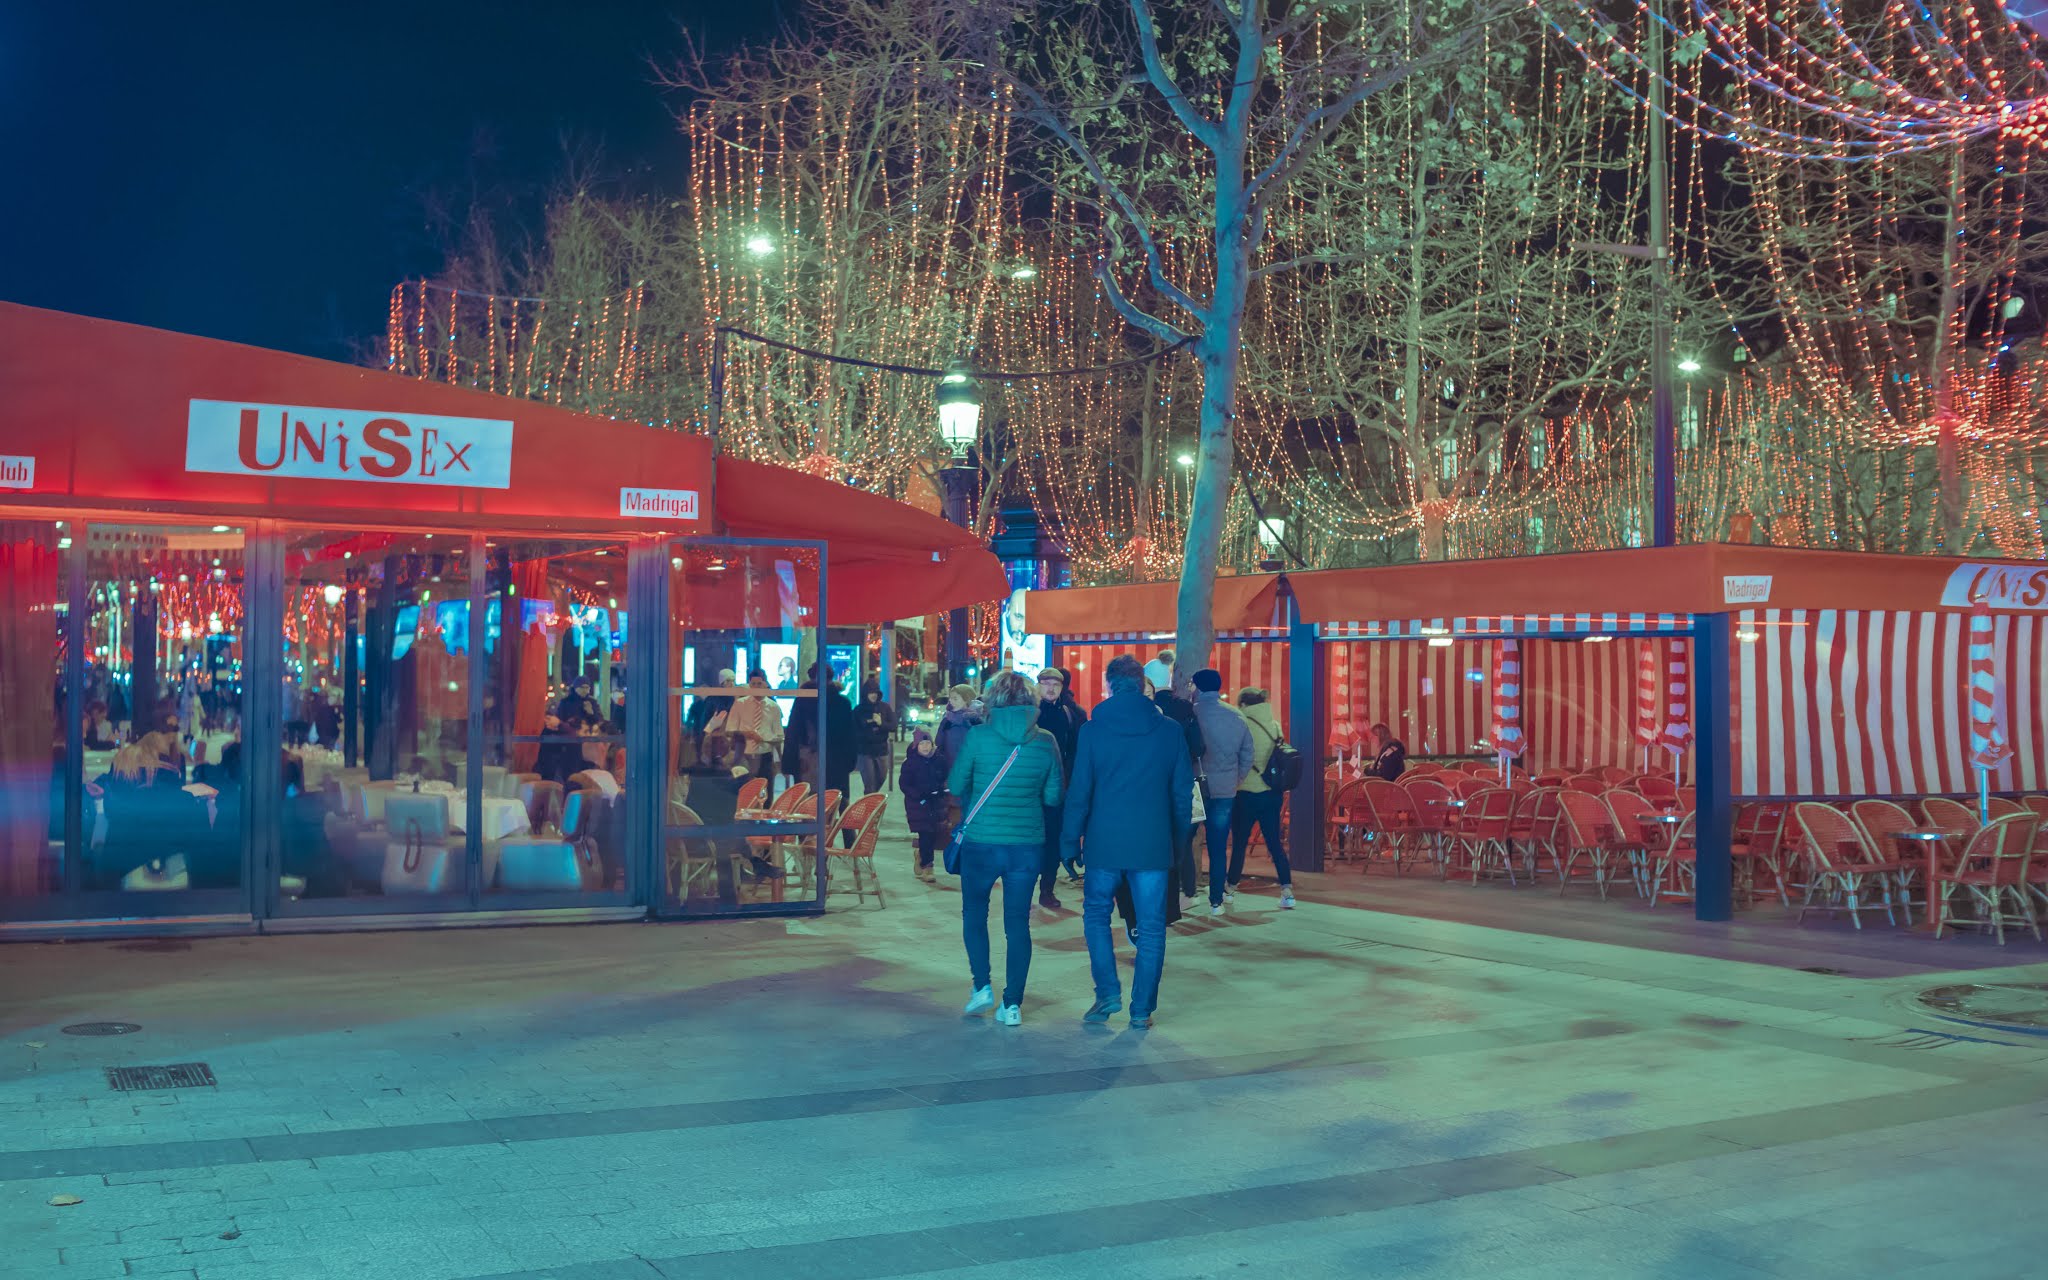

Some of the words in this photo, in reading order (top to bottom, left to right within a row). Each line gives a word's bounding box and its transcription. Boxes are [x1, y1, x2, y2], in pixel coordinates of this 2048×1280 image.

[0, 460, 28, 481] lub
[626, 492, 694, 517] Madrigal
[1726, 579, 1768, 600] Madrigal
[1967, 566, 2048, 606] UNiS
